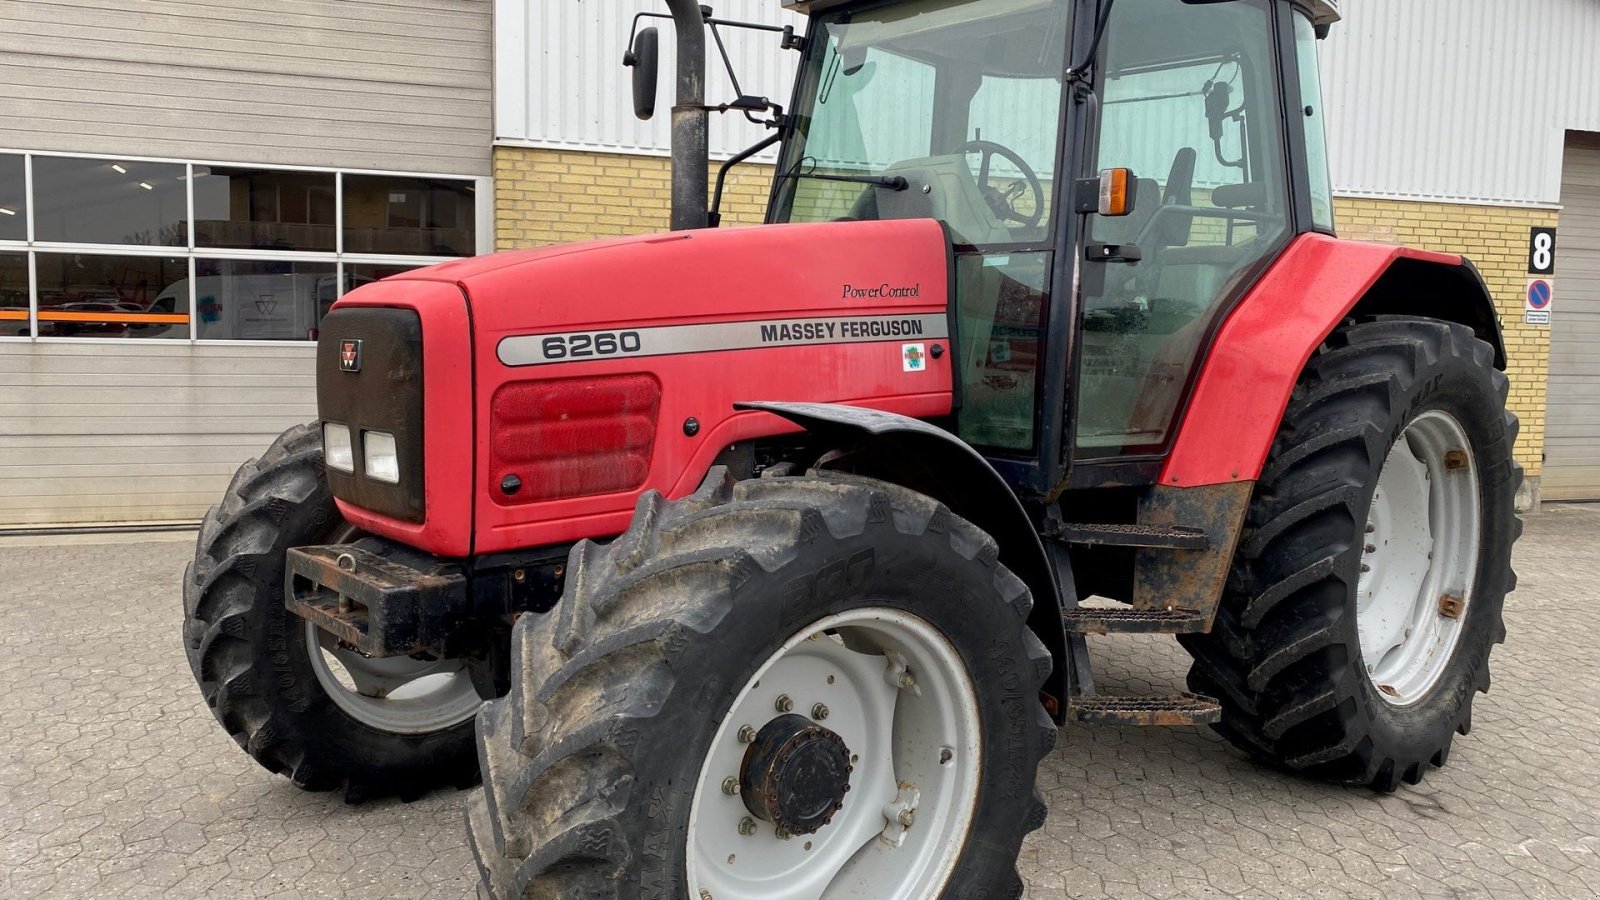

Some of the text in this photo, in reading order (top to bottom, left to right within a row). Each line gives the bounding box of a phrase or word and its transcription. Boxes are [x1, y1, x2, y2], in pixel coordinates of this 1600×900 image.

[1533, 232, 1551, 270] 8
[842, 283, 920, 299] PowerControl
[760, 319, 923, 342] MASSEY FERGUSON
[541, 331, 641, 359] 6260
